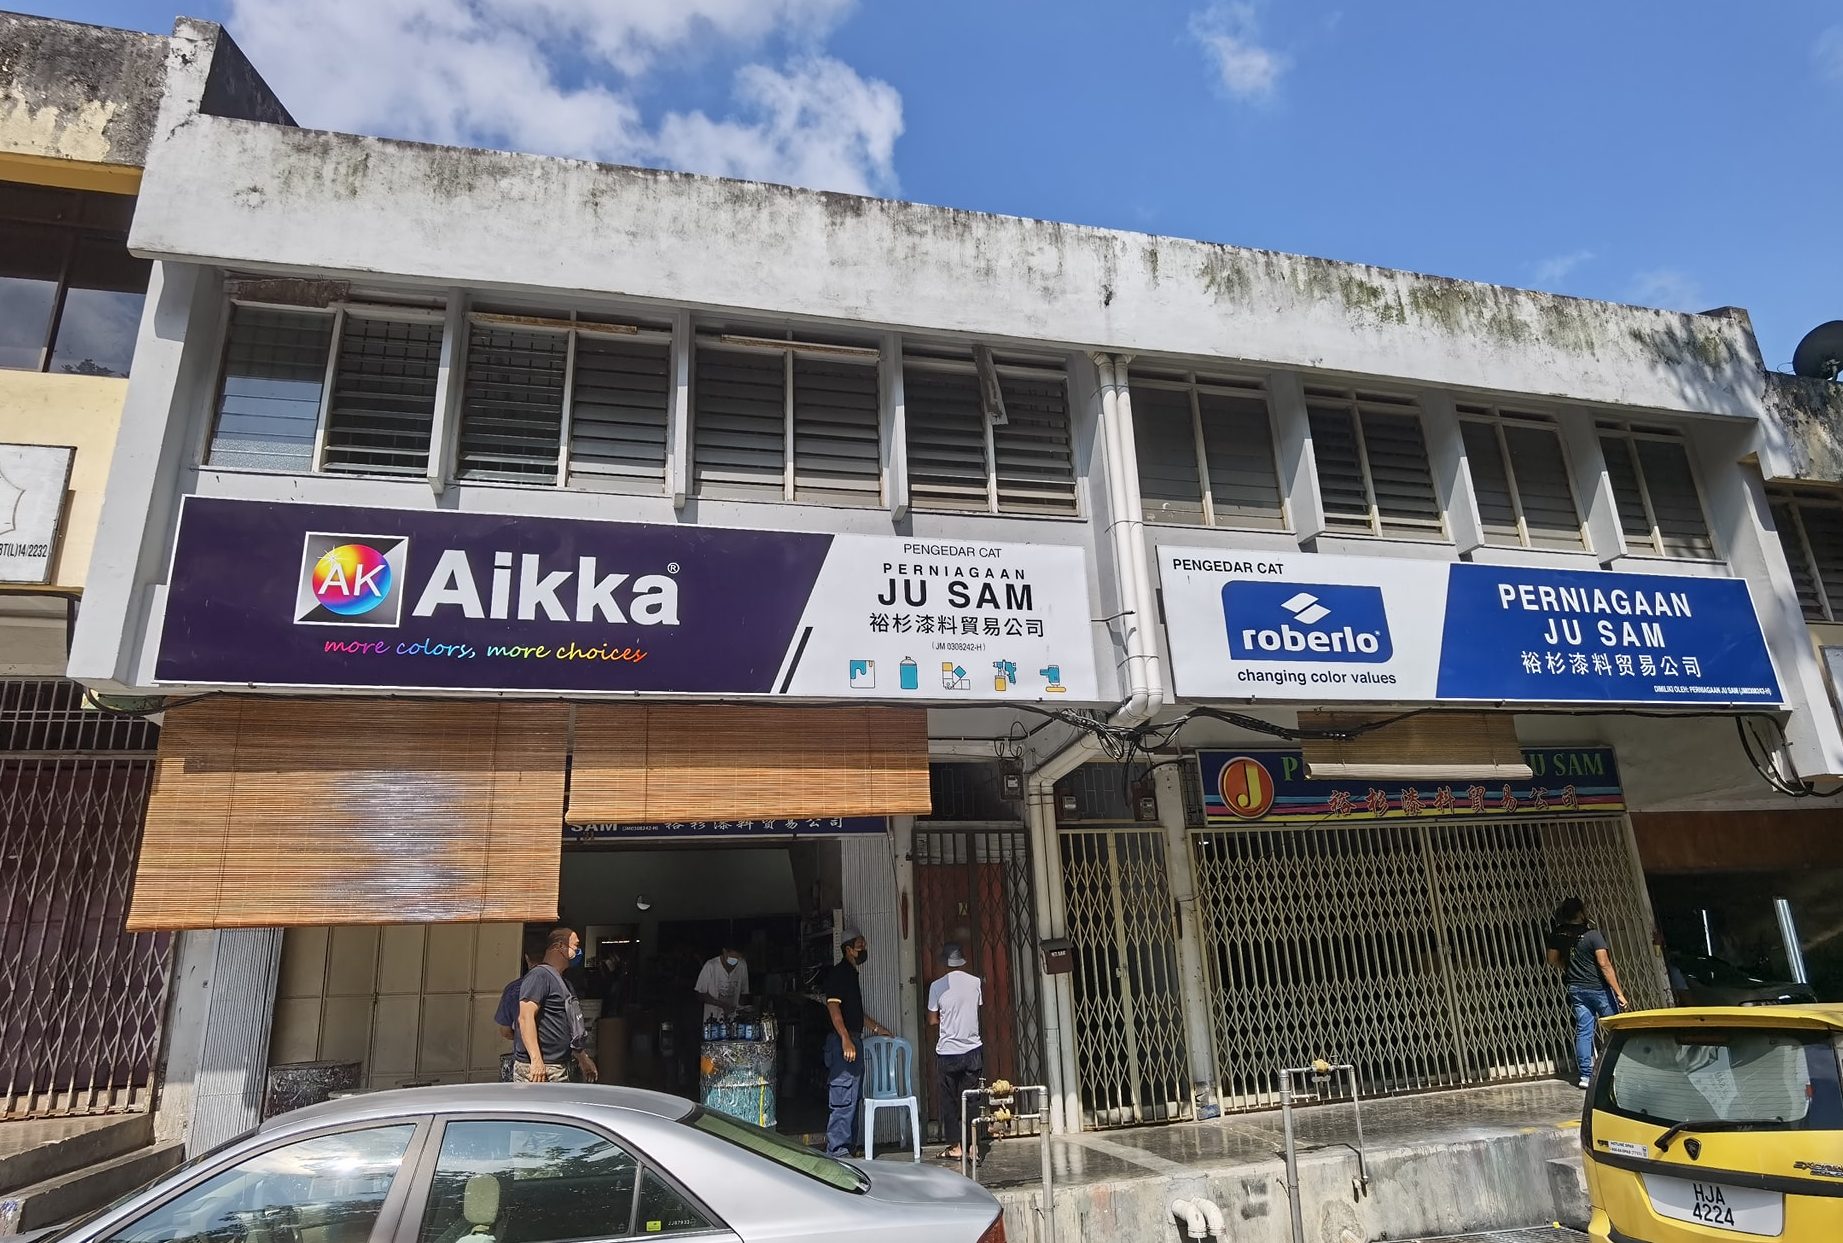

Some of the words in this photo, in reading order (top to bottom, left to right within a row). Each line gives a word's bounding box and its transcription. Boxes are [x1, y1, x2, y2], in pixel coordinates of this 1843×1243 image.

[903, 543, 976, 558] PENGEDAR
[978, 548, 1002, 559] CAT
[882, 562, 1026, 580] PERNIAGAAN
[1172, 558, 1253, 573] PENGEDAR
[1257, 562, 1284, 575] CAT
[318, 562, 387, 598] AK
[877, 578, 928, 608] JU
[947, 580, 1034, 612] SAM
[1497, 583, 1693, 618] PERNIAGAAN
[869, 612, 1045, 639] 裕杉漆料貿易公司
[1543, 618, 1583, 646] JU
[1597, 620, 1667, 648] SAM
[323, 638, 390, 656] more
[396, 637, 477, 659] colors,
[486, 643, 551, 662] more
[556, 642, 649, 663] choices
[1237, 668, 1307, 685] changing
[1310, 670, 1347, 684] color
[1350, 671, 1397, 685] values
[1520, 650, 1702, 678] 裕杉漆料贸易公司
[1553, 753, 1604, 777] SAM
[1692, 1182, 1725, 1206] HJA
[1692, 1202, 1735, 1227] 4224
